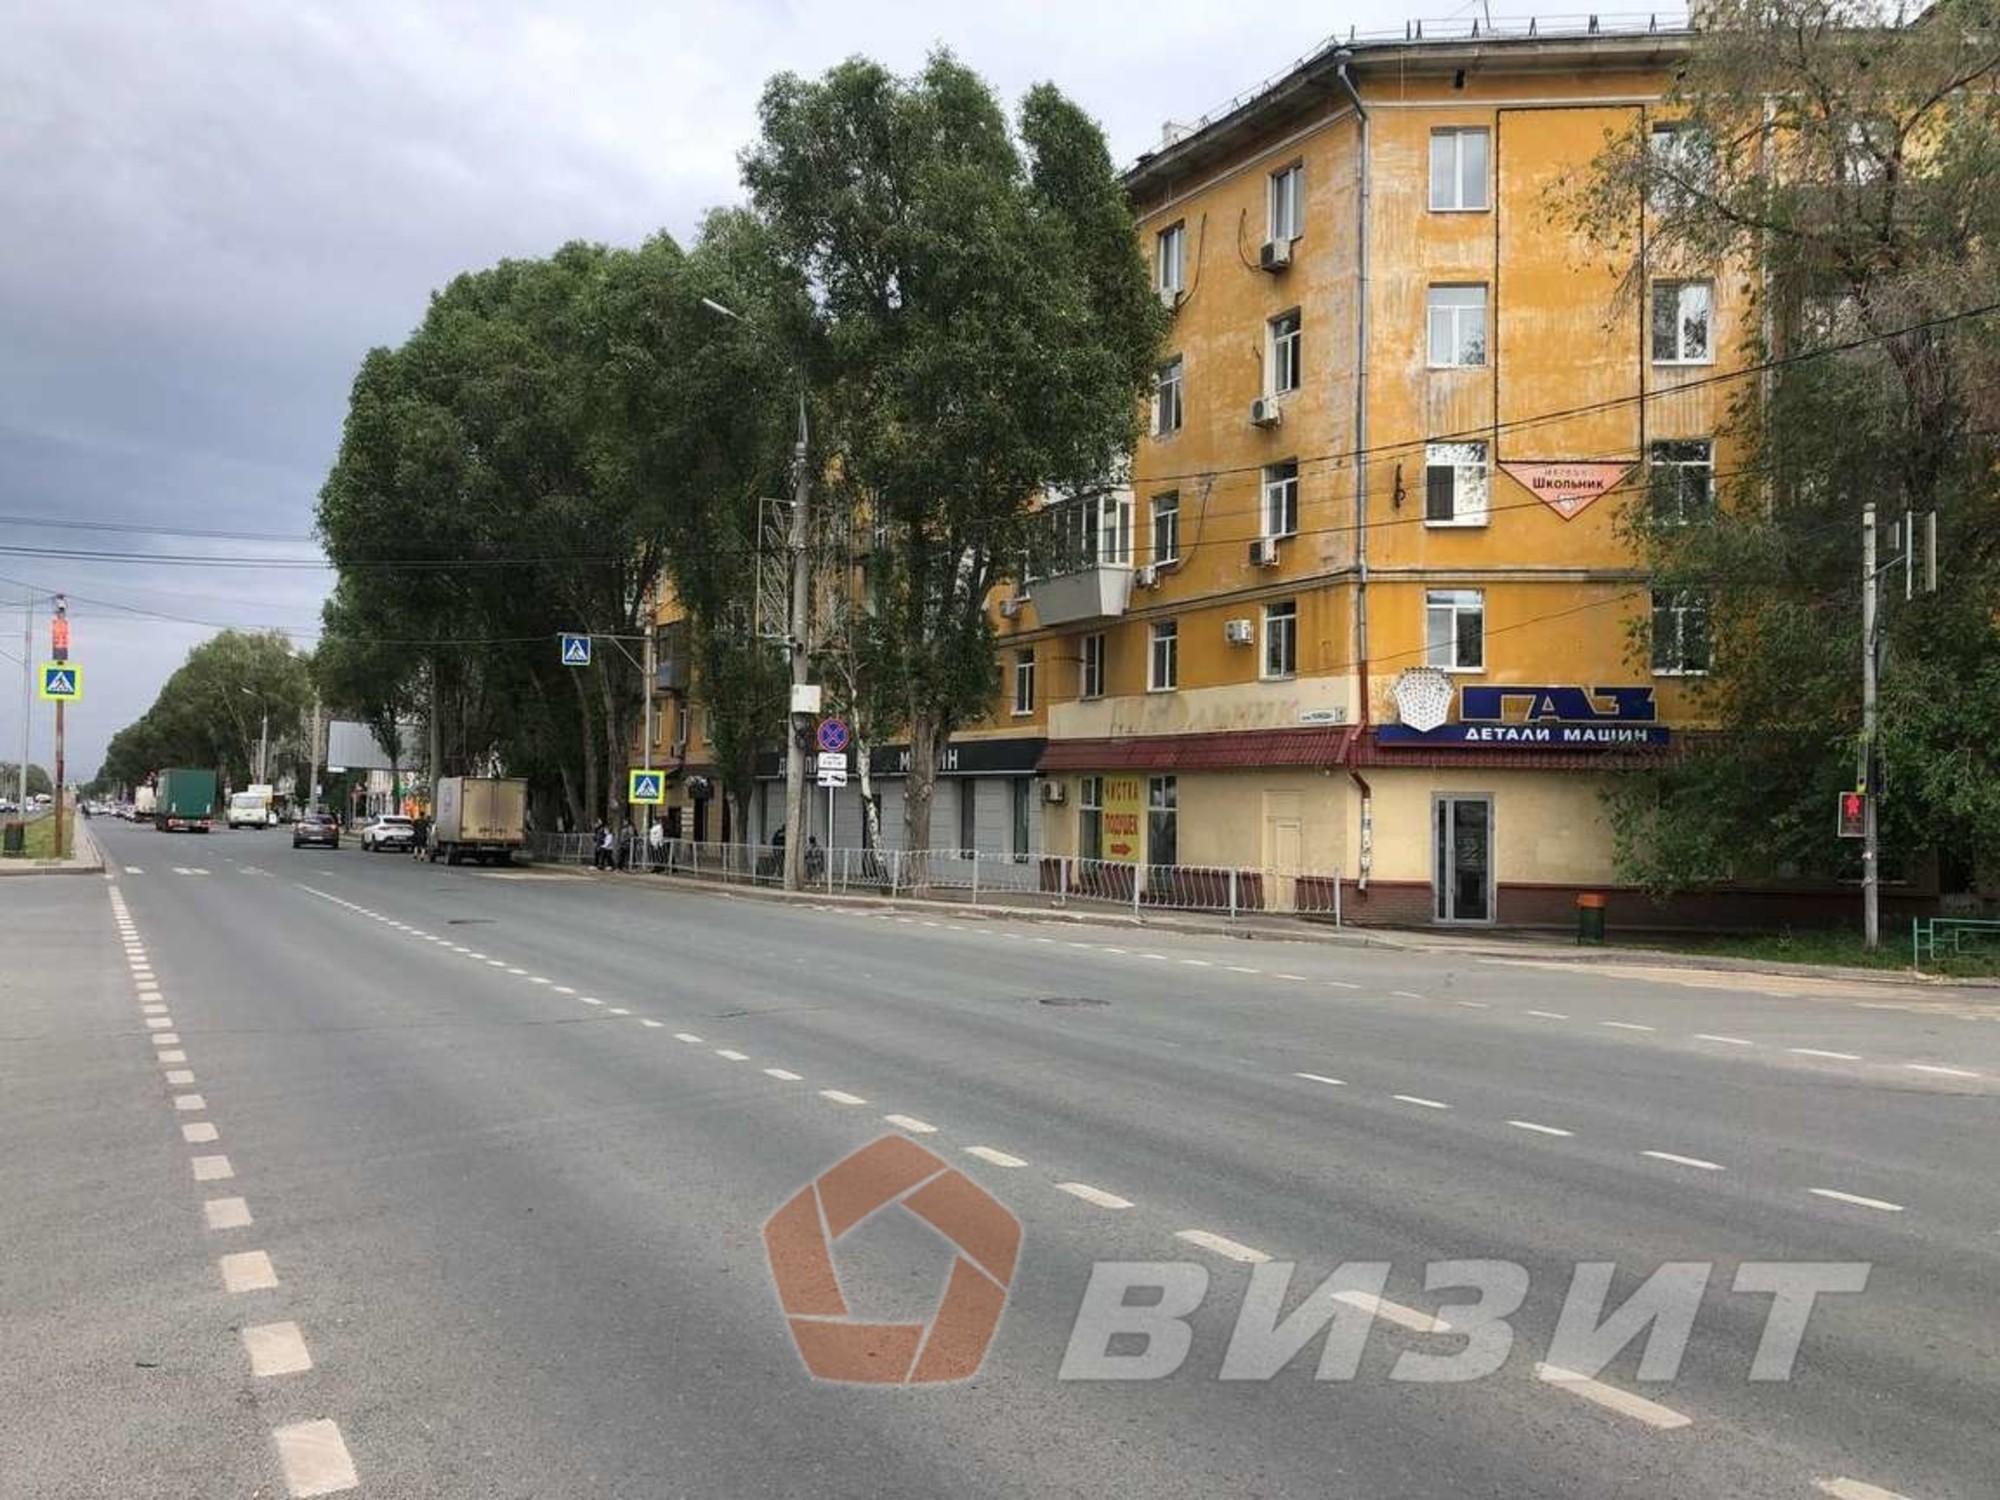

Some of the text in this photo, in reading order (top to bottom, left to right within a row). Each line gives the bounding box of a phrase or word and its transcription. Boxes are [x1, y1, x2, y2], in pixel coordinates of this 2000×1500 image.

[1532, 477, 1604, 489] Школьник
[1460, 685, 1657, 722] ГАЗ
[1465, 728, 1649, 742] ДЕТАЛИ МАШИН
